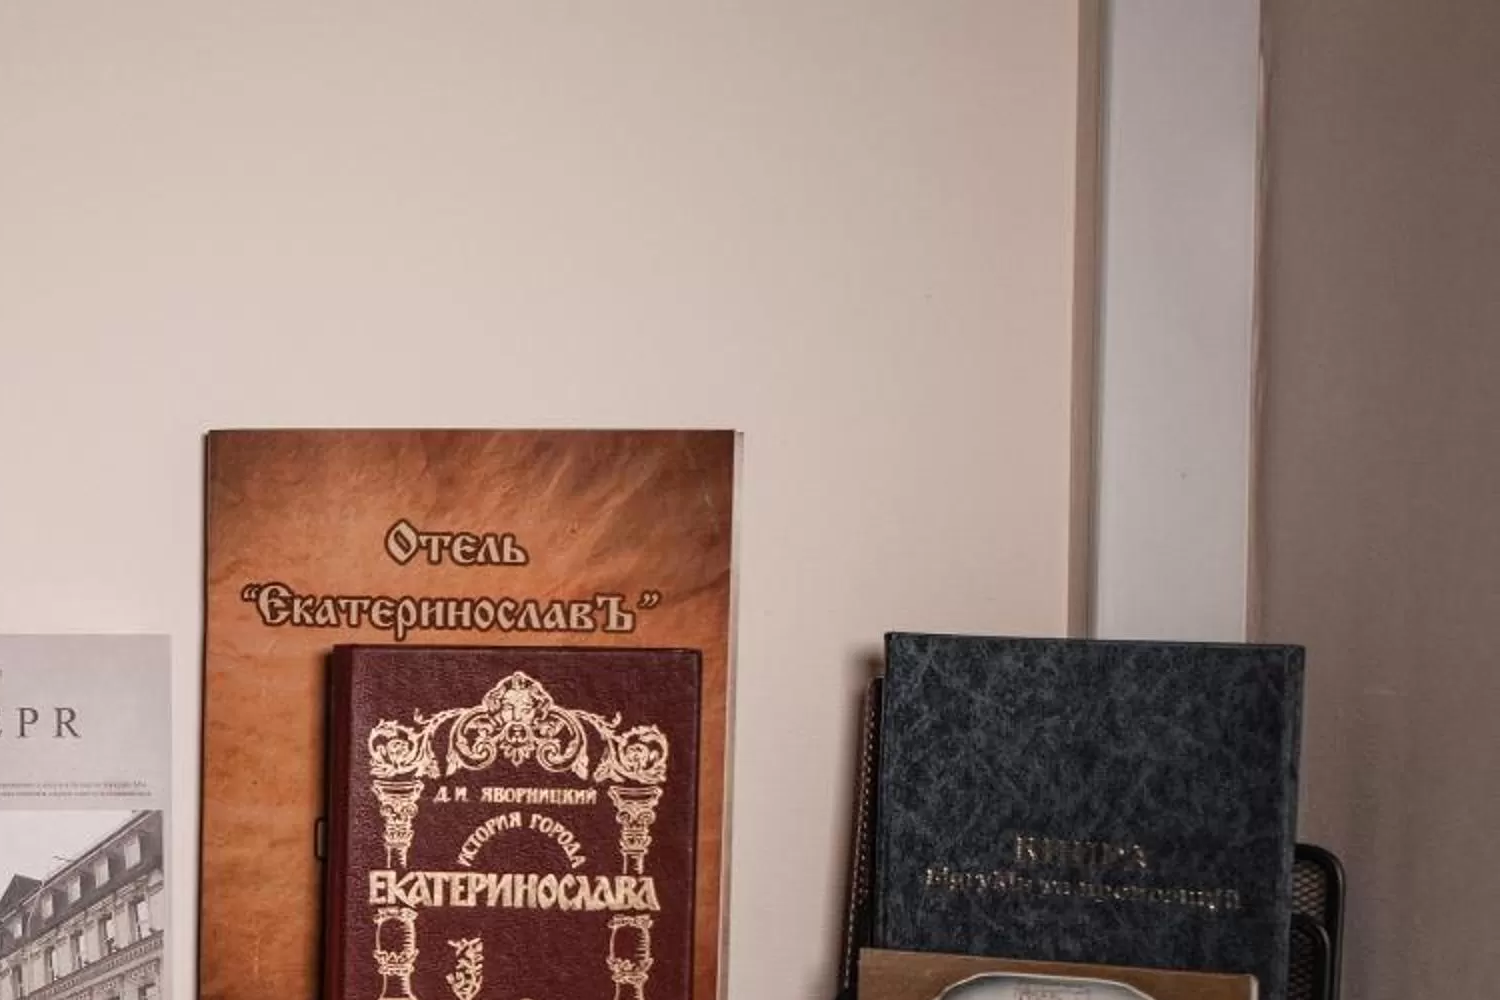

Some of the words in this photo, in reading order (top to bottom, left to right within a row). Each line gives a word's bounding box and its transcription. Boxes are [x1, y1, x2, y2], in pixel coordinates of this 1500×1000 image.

[480, 785, 597, 806] ЯВОРНИЦКИЙ
[456, 810, 524, 868] ИСТОРИЯ
[529, 812, 587, 870] ГОРОДА
[368, 869, 662, 912] ЕКАТЕРИНОСЛАВА
